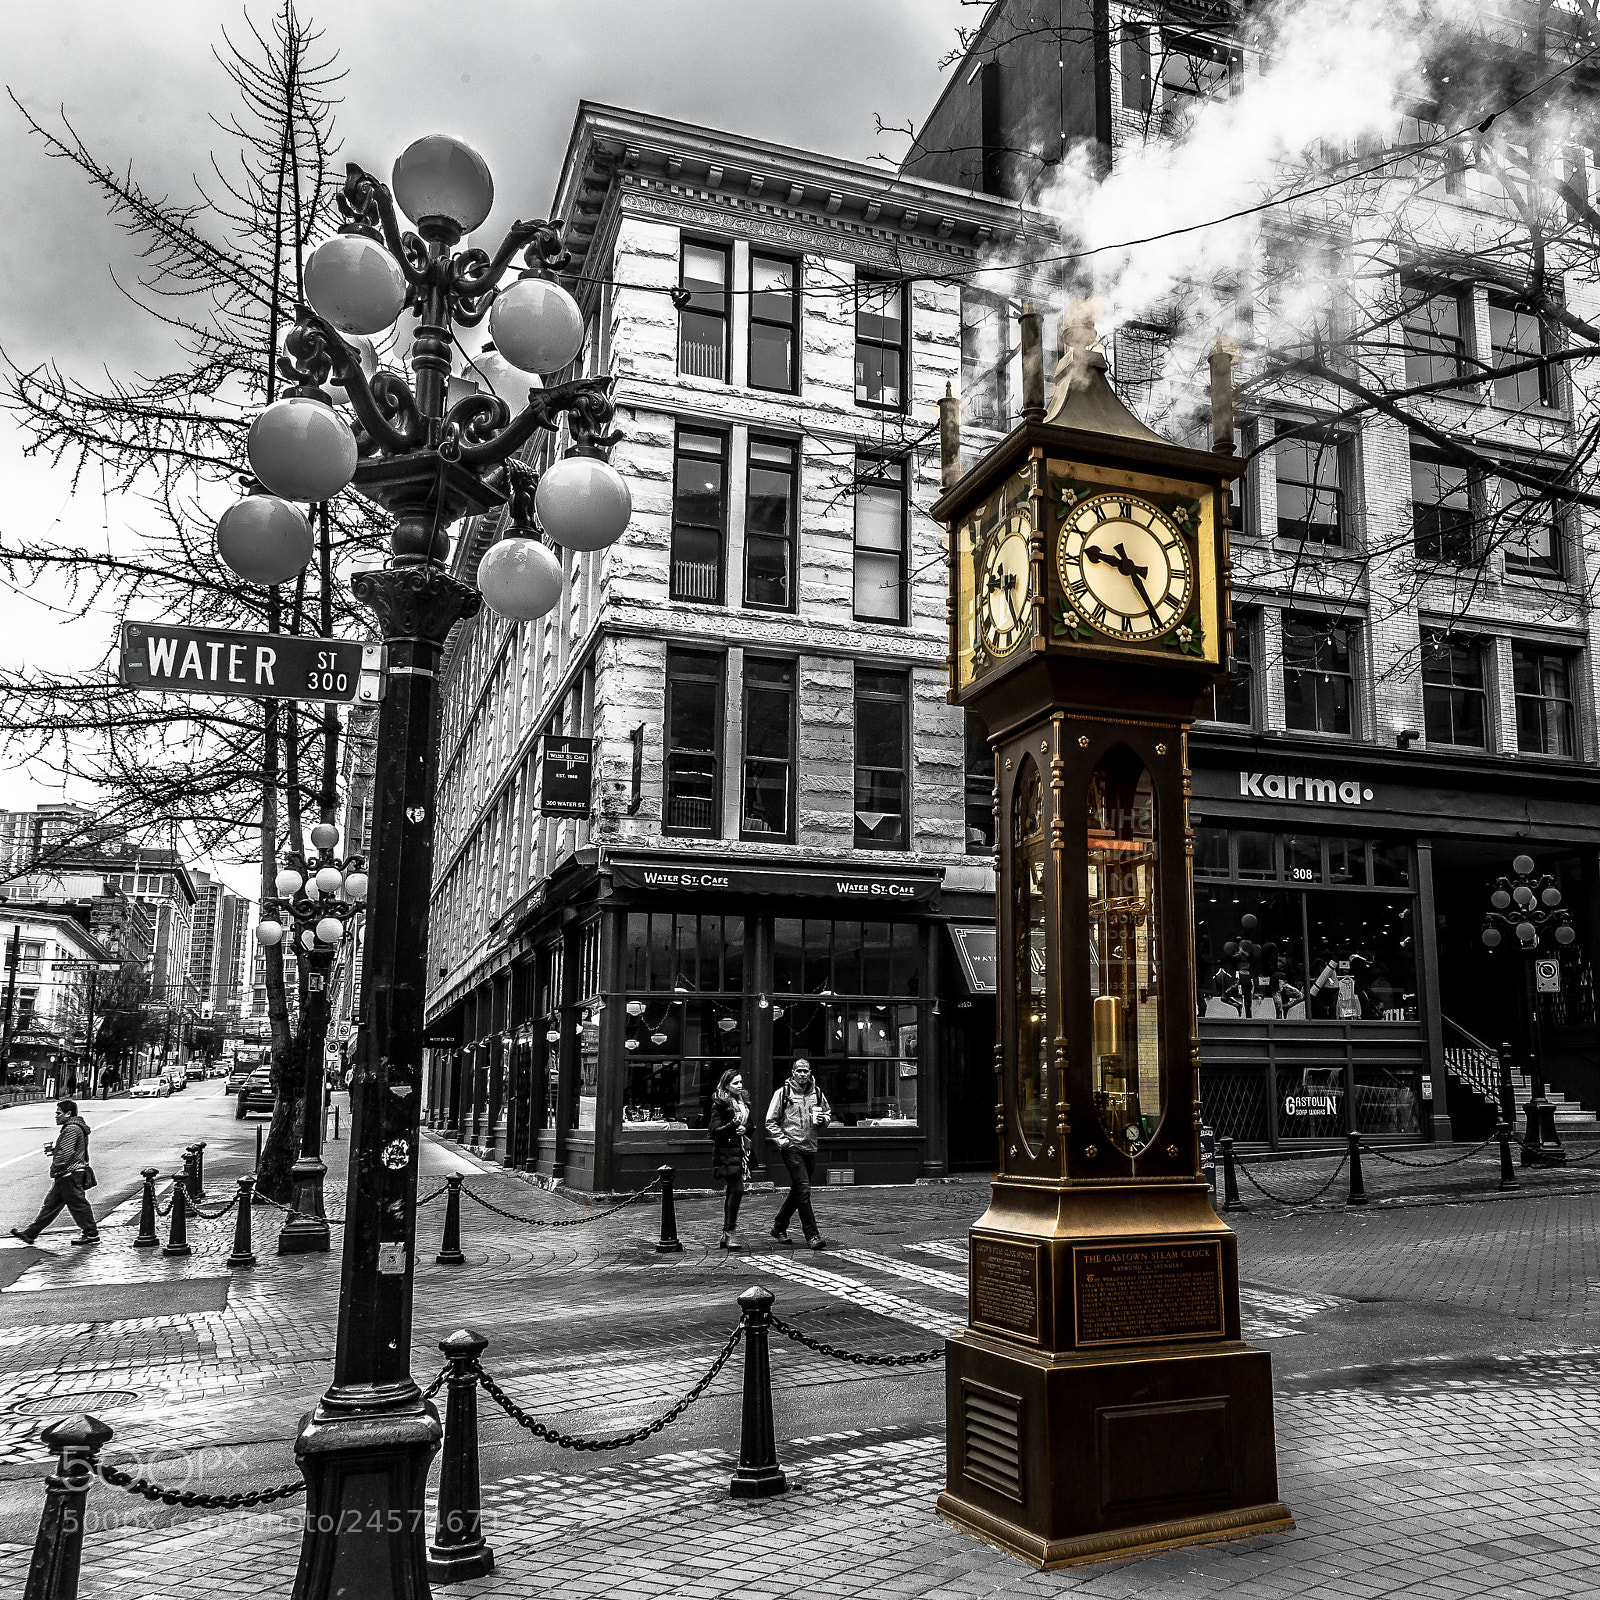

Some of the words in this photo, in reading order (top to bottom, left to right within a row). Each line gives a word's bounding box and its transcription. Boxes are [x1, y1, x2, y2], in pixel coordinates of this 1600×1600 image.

[147, 636, 277, 686] WATER
[317, 651, 338, 671] ST
[307, 672, 348, 692] 300
[644, 872, 679, 885] WATER
[701, 875, 729, 888] CAFE
[1293, 868, 1313, 880] 308
[837, 882, 869, 894] WATER
[1285, 1096, 1337, 1116] GASTOWN
[1083, 1254, 1101, 1264] THE
[1104, 1252, 1148, 1263] GASTOWN
[1151, 1250, 1178, 1260] STEAM
[1181, 1249, 1210, 1258] CLOCK
